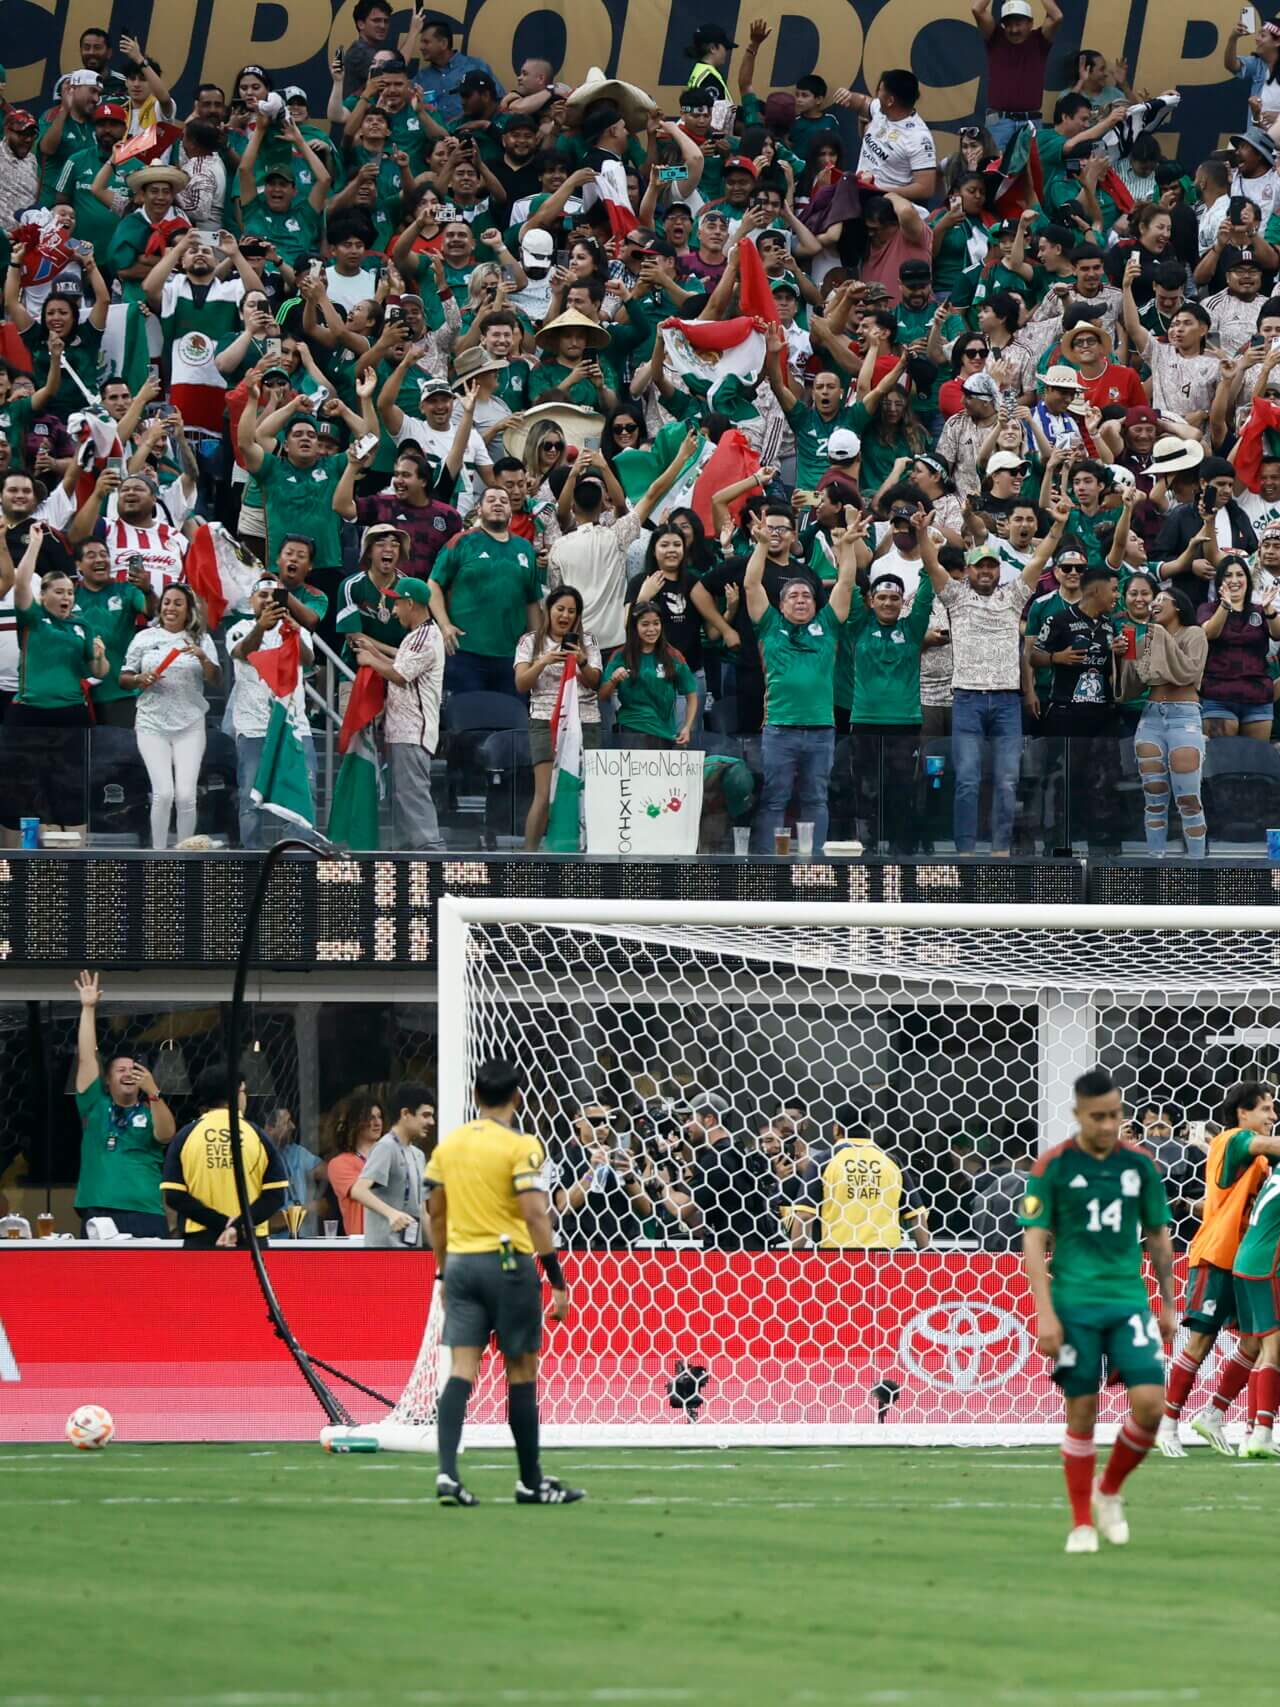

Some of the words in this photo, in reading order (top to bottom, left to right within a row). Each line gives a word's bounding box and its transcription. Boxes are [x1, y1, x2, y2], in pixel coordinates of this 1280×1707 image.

[1081, 652, 1108, 666] elcel
[204, 1128, 243, 1143] CS
[207, 1157, 235, 1169] STA
[845, 1160, 881, 1174] CSC
[1086, 1198, 1123, 1233] 14
